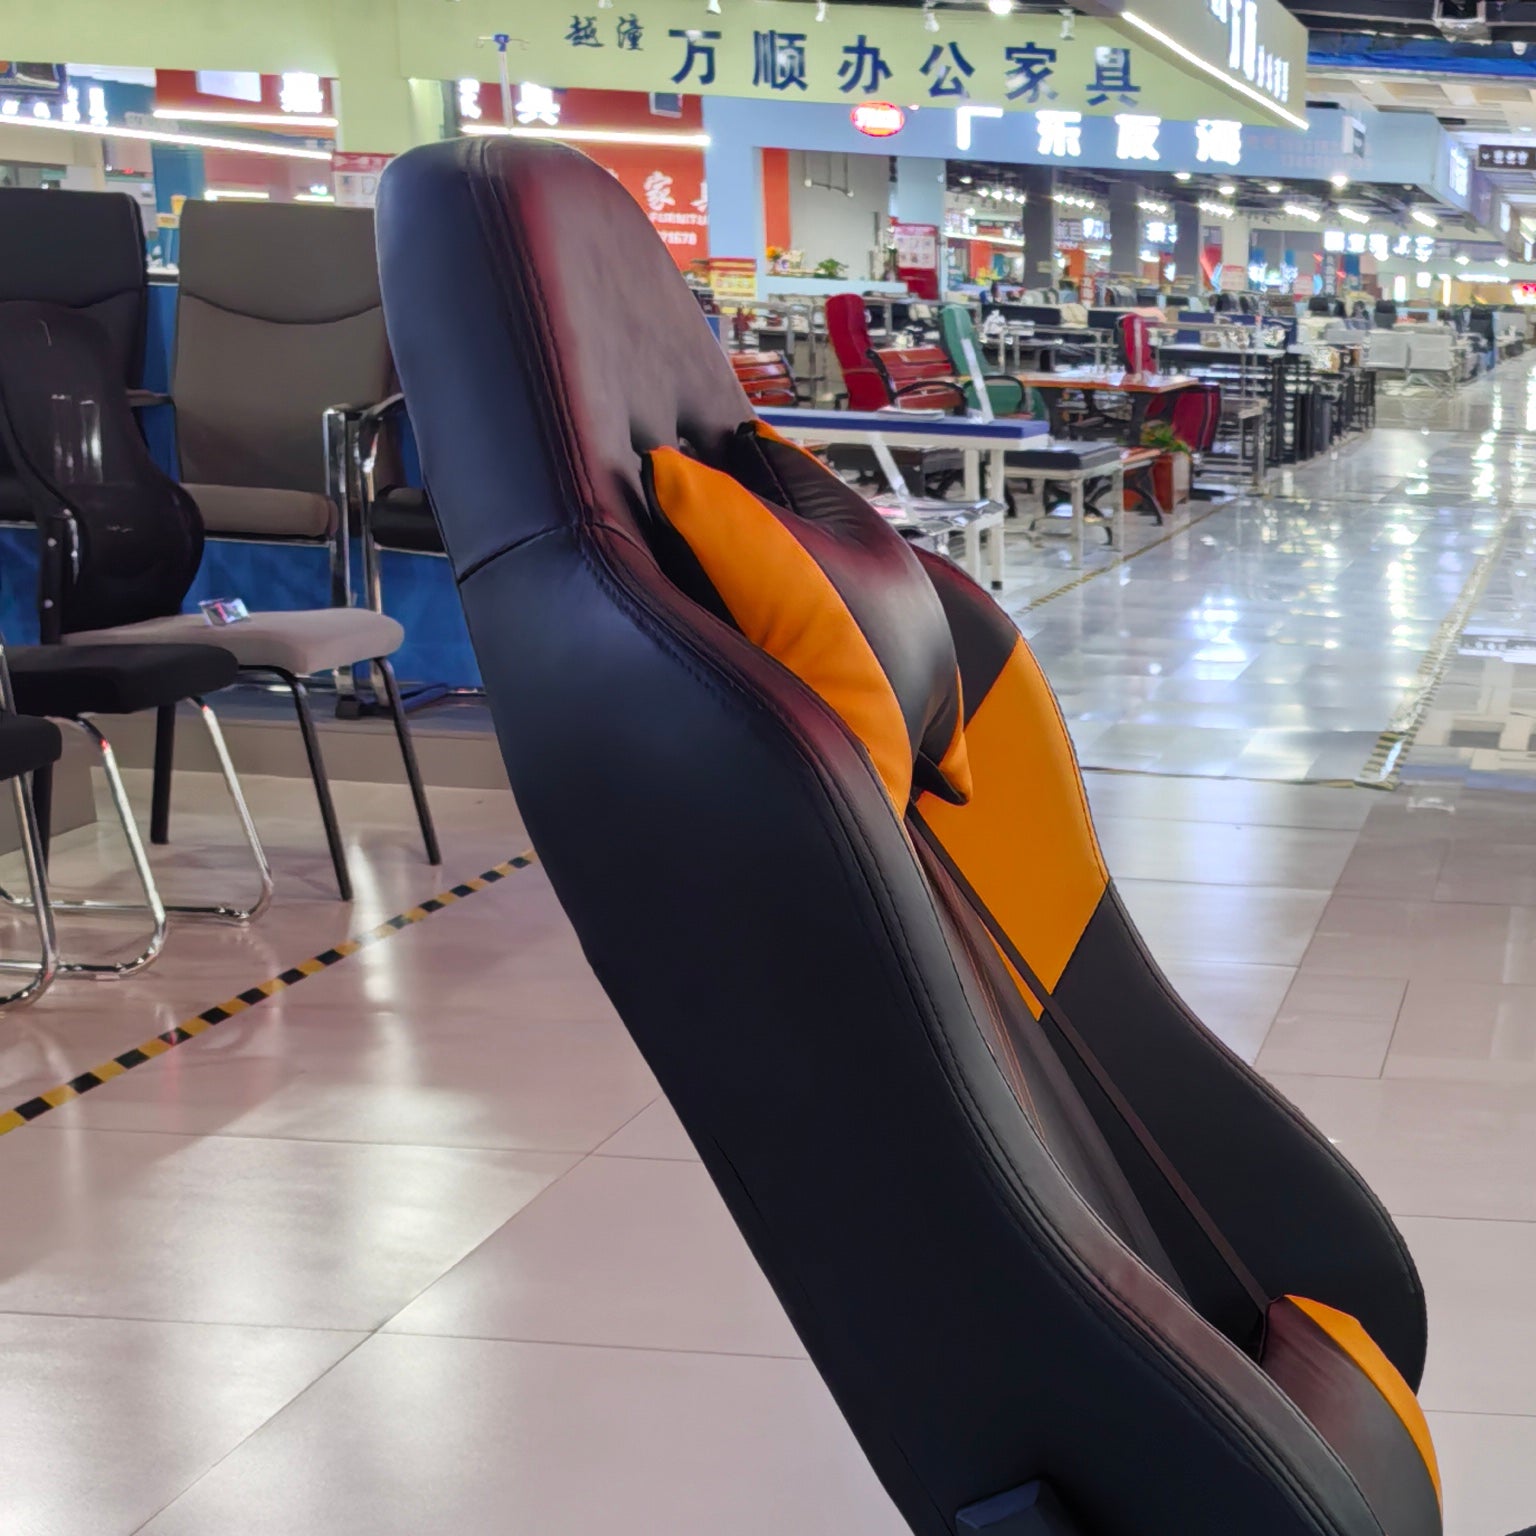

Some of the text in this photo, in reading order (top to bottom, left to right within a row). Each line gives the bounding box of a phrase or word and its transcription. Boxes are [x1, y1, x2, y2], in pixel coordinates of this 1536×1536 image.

[668, 29, 1142, 108] 万顺办公家具
